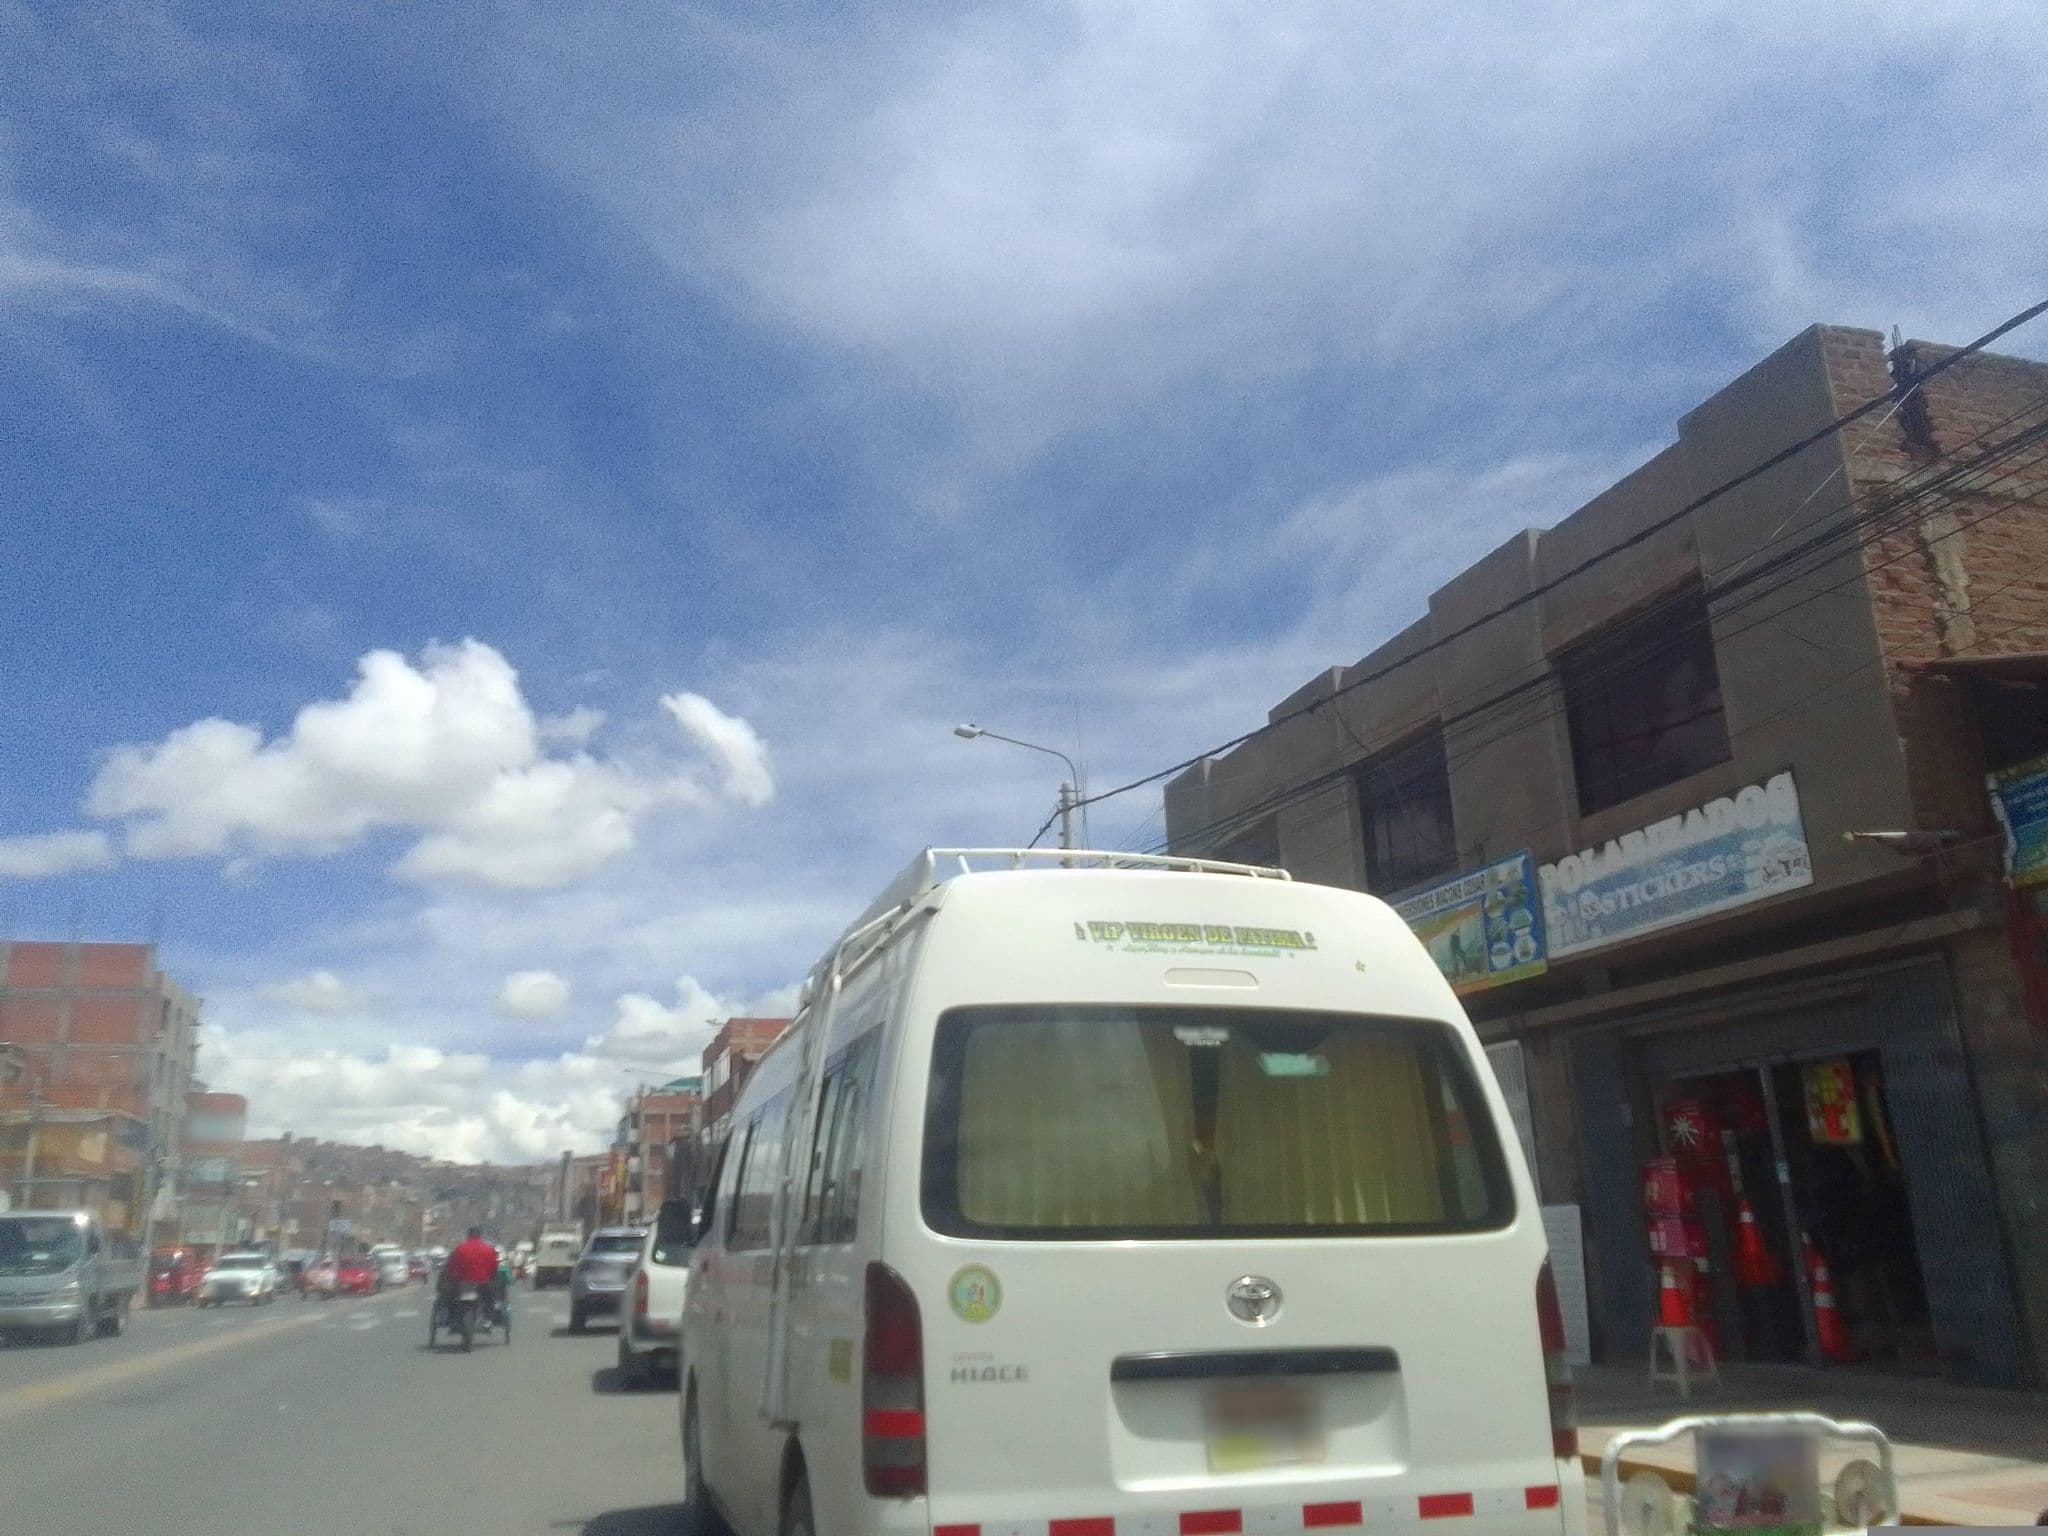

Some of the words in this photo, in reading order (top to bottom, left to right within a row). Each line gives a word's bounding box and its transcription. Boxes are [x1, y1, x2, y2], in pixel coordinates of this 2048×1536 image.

[1600, 855, 1727, 915] STICKERS
[1088, 921, 1124, 942] VIP
[1125, 922, 1202, 943] VIRGEN
[1203, 925, 1233, 945] DE
[951, 1364, 1029, 1383] HIACE
